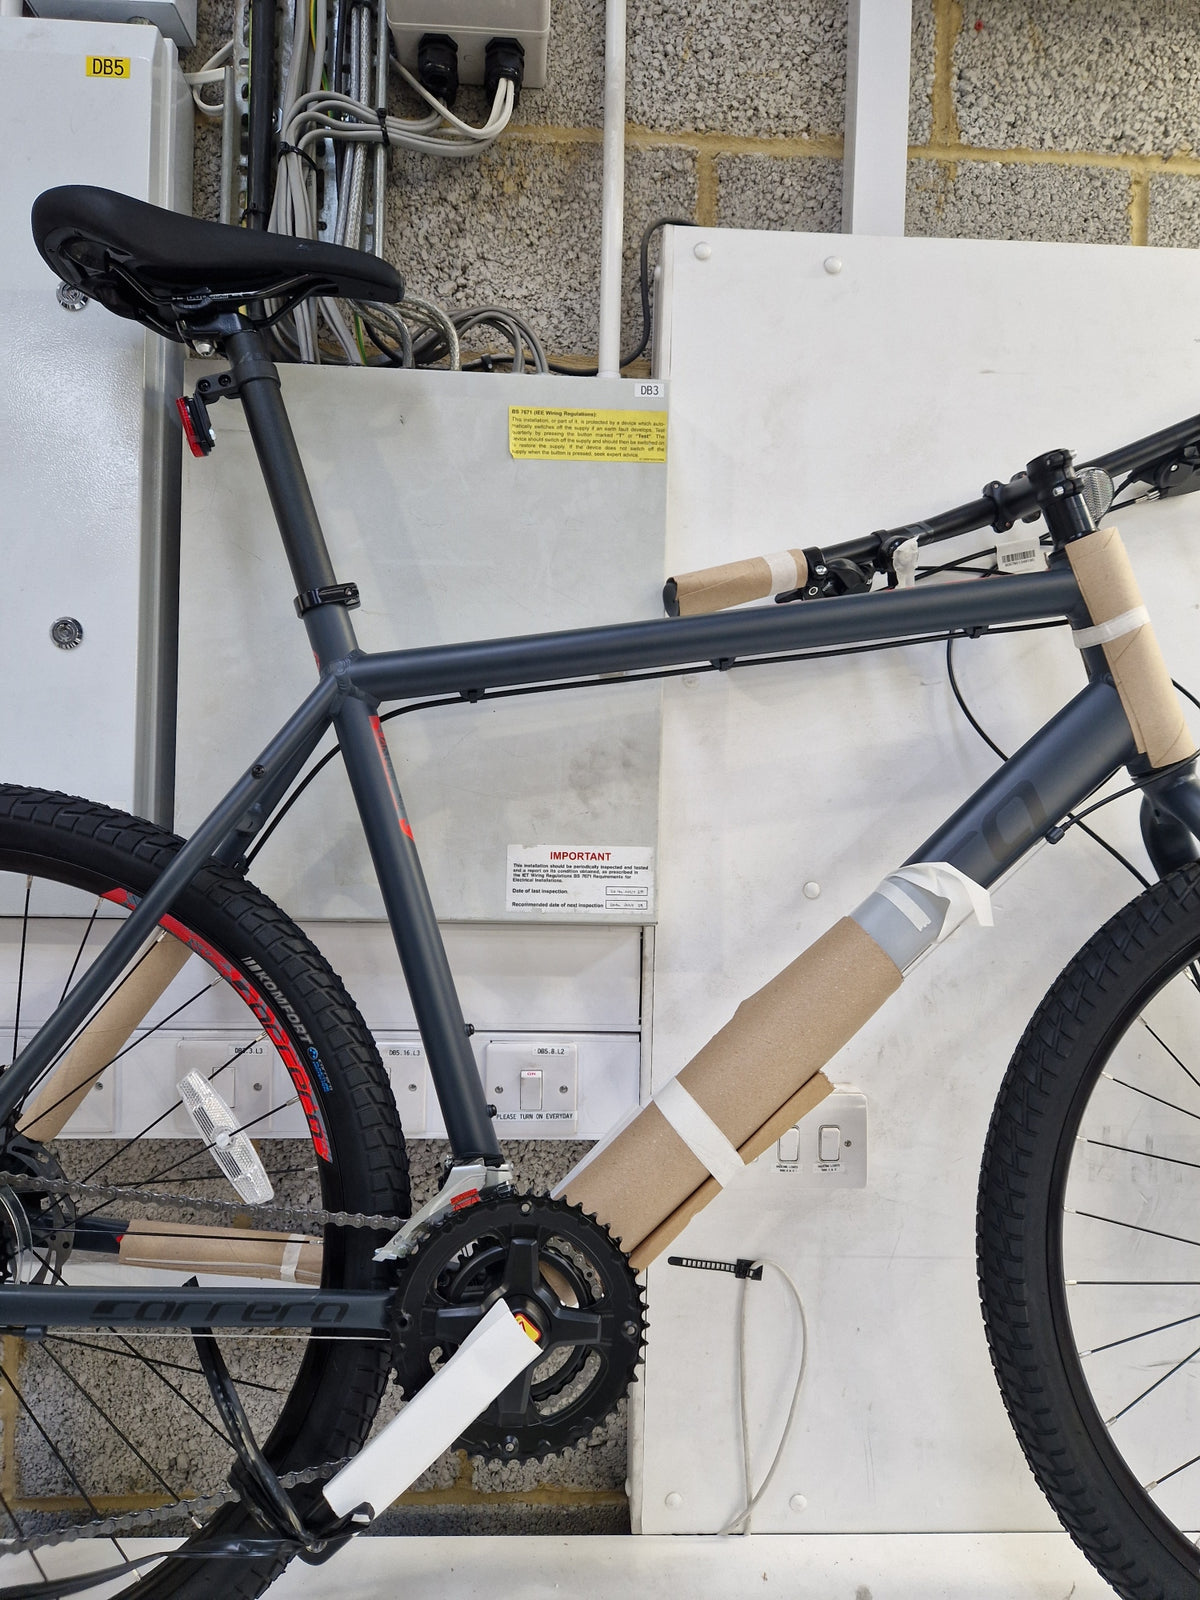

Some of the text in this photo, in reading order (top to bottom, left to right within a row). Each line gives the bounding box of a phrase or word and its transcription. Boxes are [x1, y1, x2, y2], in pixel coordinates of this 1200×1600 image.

[93, 58, 124, 76] DB5
[640, 385, 659, 395] DB3
[550, 851, 612, 861] IMPORTANT
[256, 971, 314, 1045] KOMFORT
[388, 1049, 420, 1057] DB5.16.L3
[537, 1047, 565, 1055] DB5.8.L2
[89, 1300, 350, 1323] carrera
